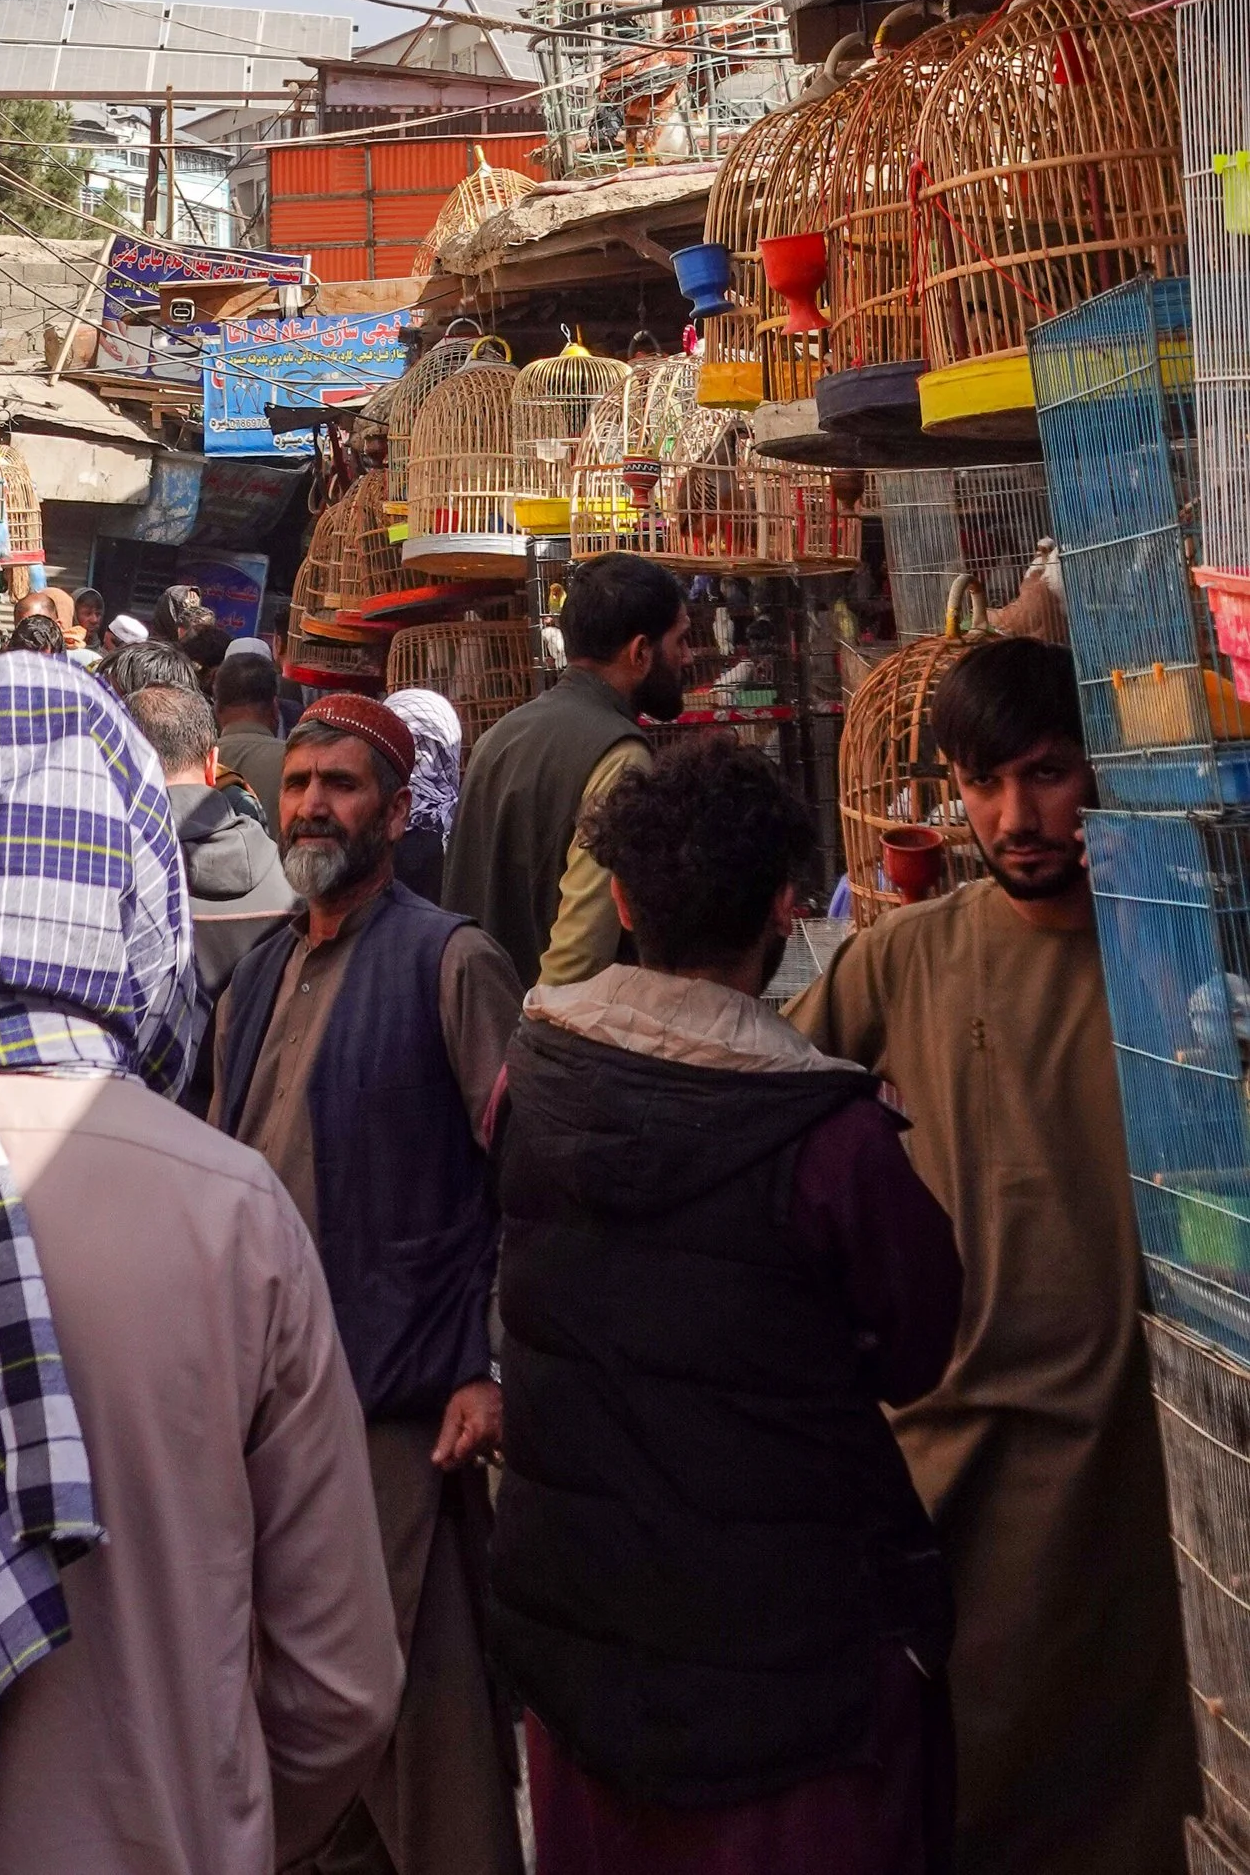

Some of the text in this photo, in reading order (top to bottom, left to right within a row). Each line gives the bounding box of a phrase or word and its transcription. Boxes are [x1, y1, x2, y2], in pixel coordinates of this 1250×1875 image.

[138, 248, 164, 272] عباس
[280, 318, 317, 343] استاد
[321, 317, 359, 348] سازی
